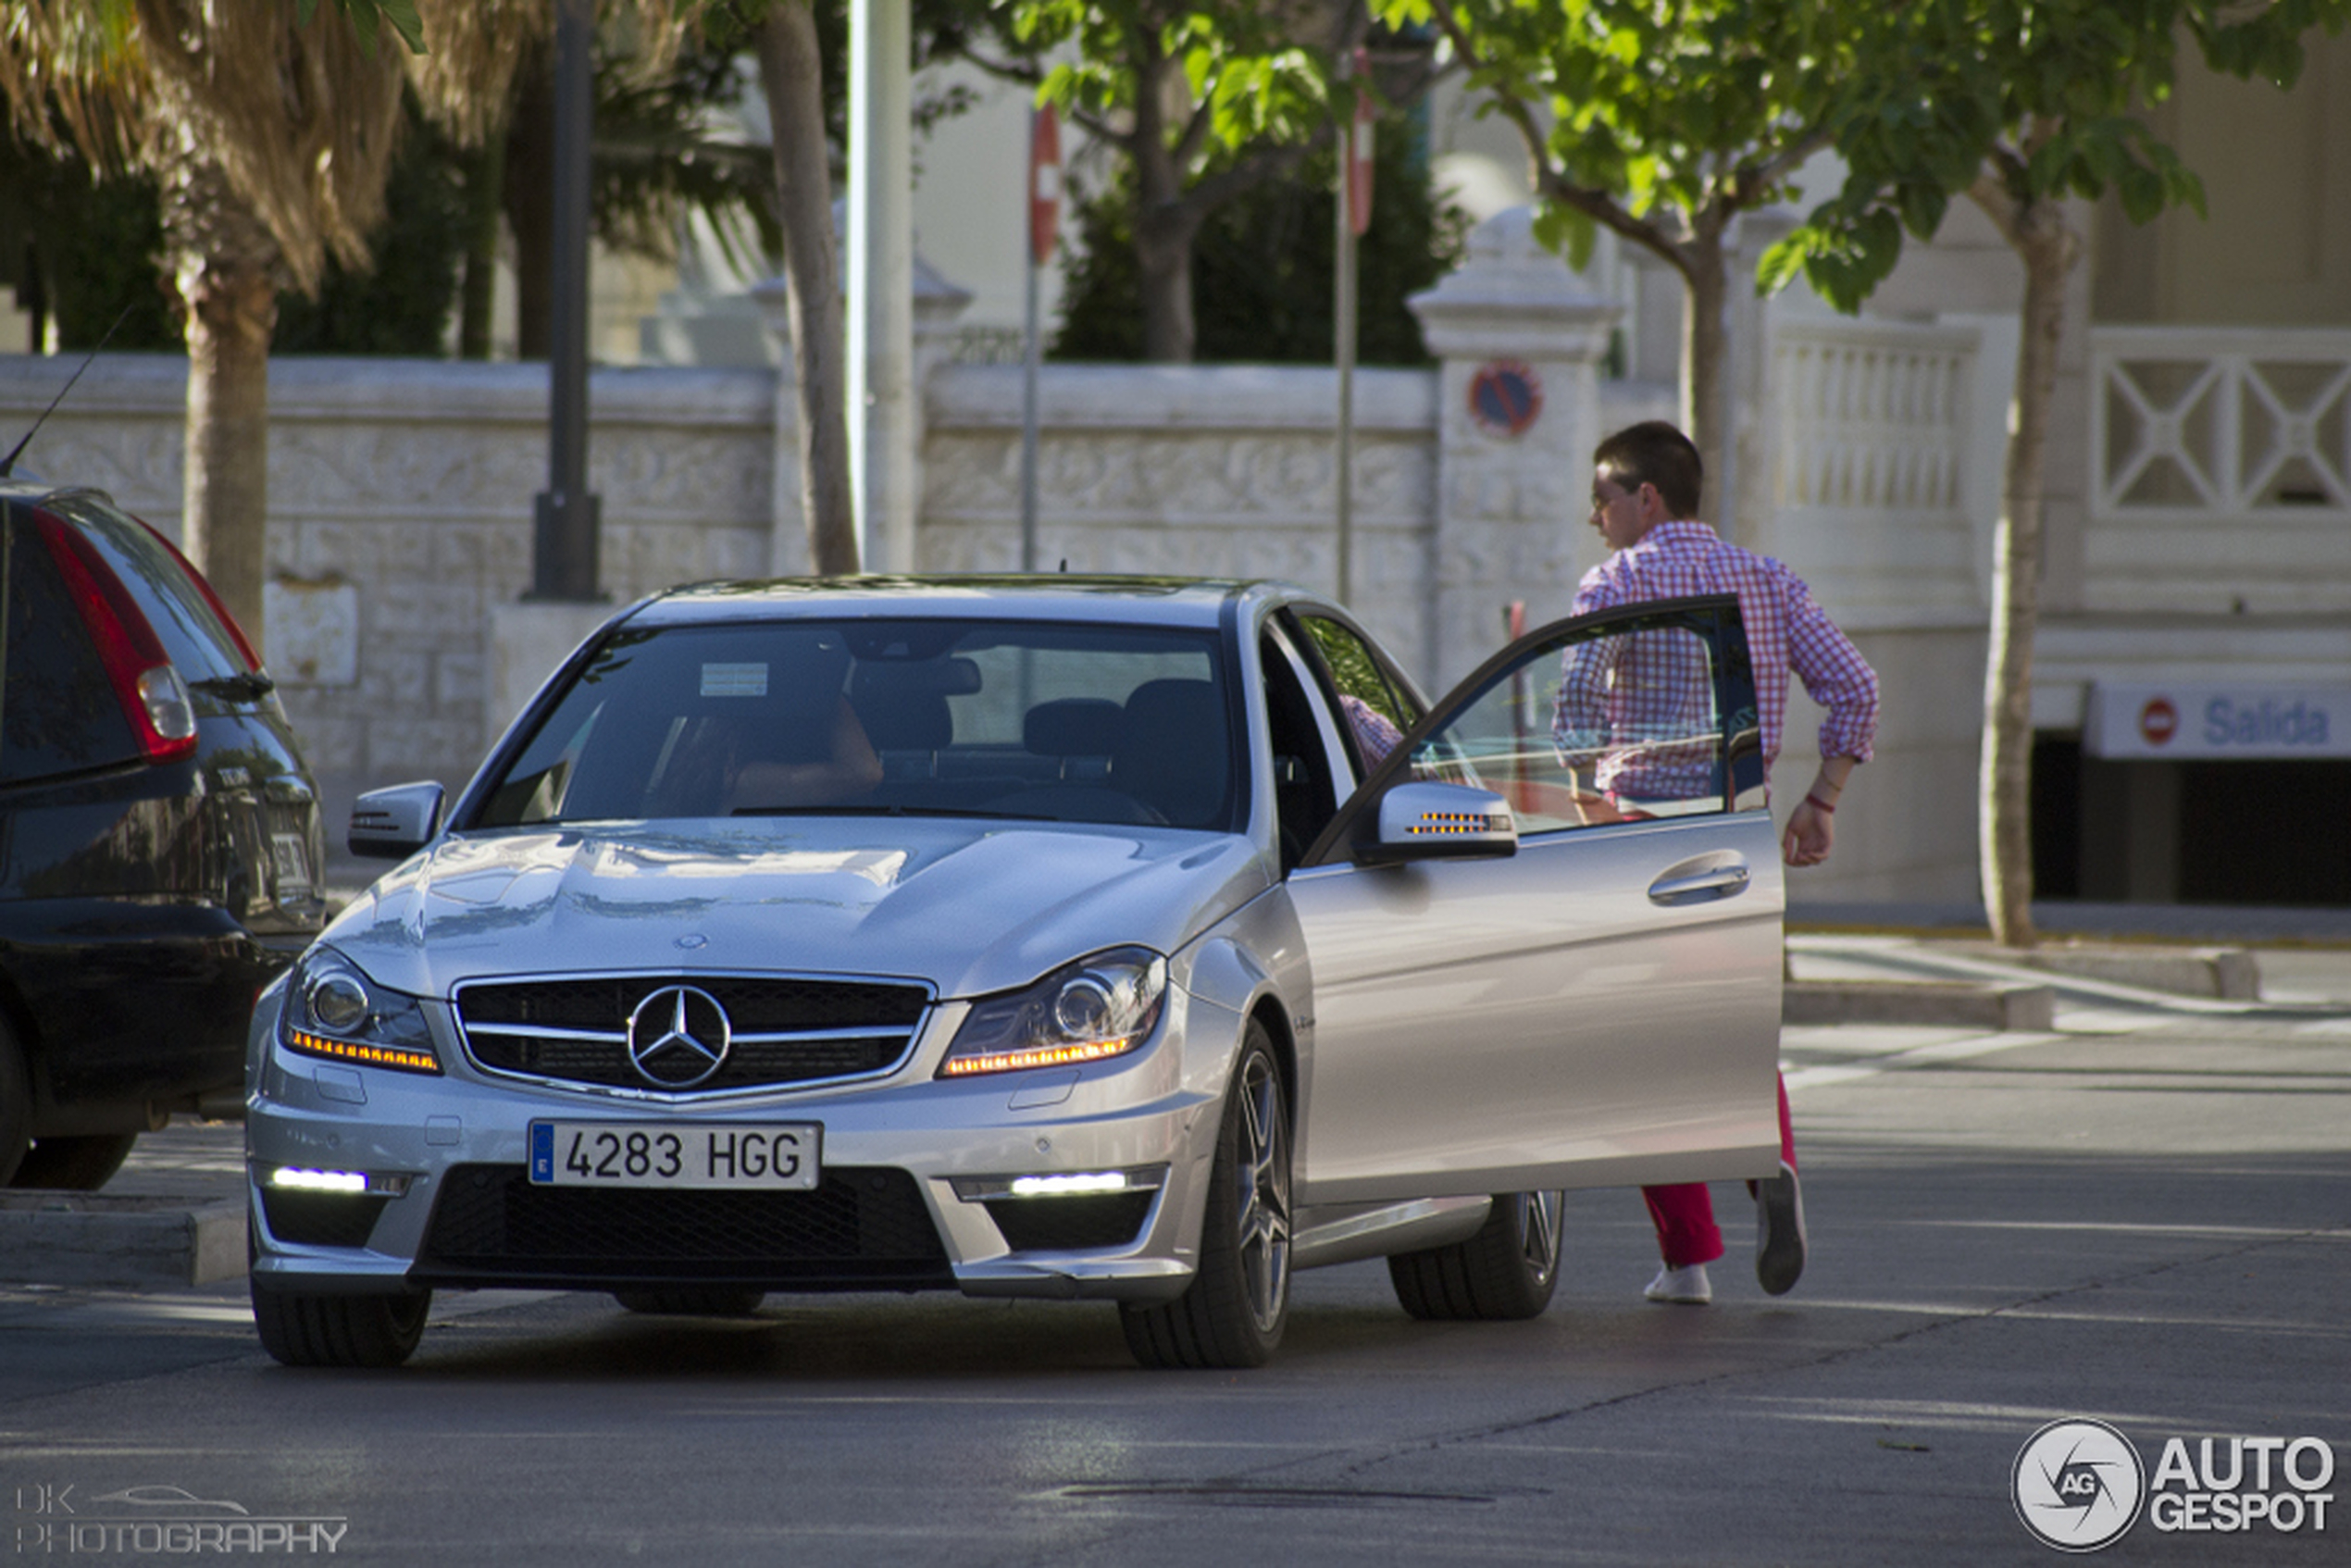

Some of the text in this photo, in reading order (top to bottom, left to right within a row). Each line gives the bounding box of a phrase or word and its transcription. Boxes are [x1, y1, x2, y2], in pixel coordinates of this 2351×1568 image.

[2203, 695, 2330, 745] Salida
[538, 1158, 548, 1174] E
[566, 1131, 800, 1179] 4283 HGG
